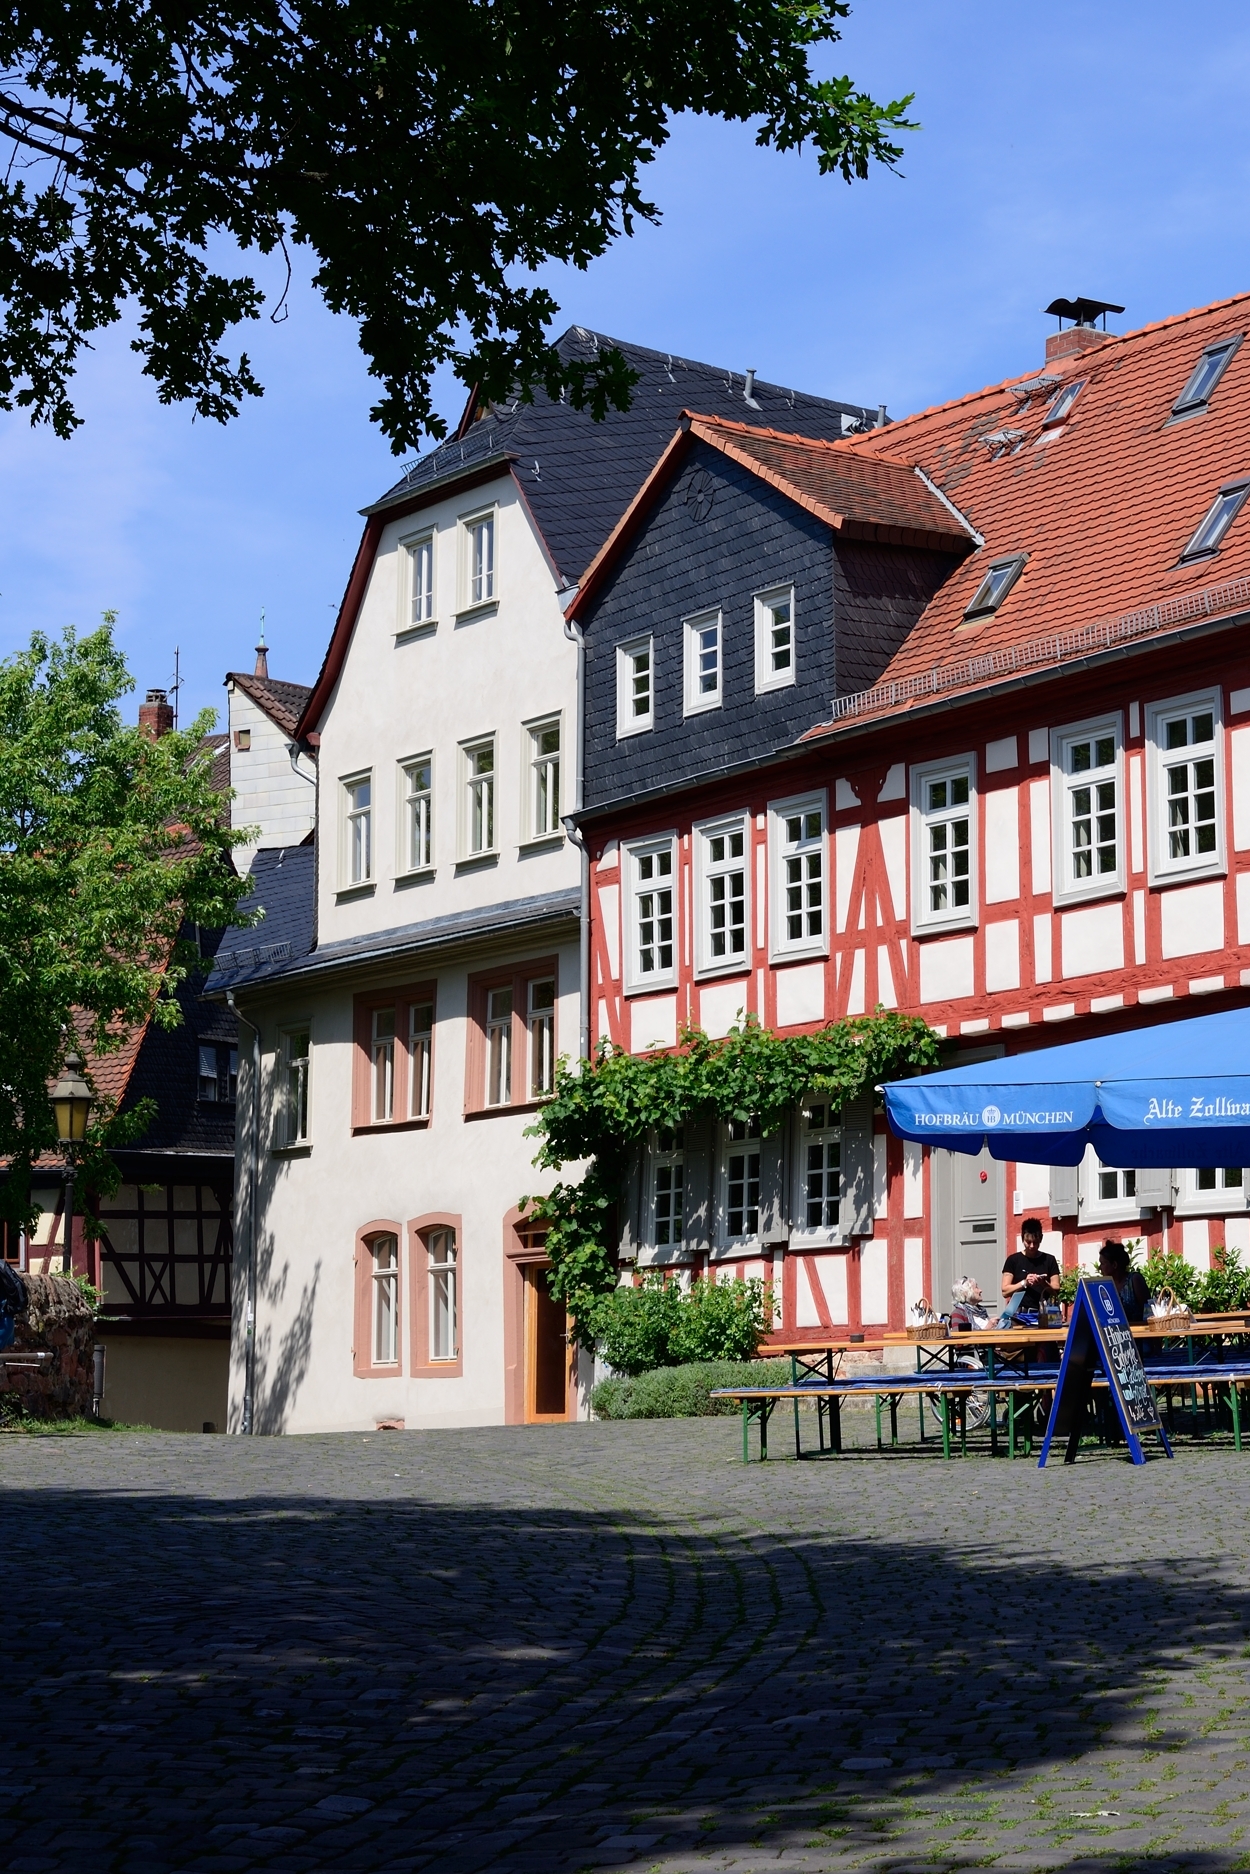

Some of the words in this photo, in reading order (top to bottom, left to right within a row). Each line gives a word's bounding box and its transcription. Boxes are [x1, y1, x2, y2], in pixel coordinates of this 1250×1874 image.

[915, 1111, 980, 1126] HOFBRÄU
[1003, 1111, 1073, 1125] MÜNCHEN
[1143, 1097, 1183, 1125] Alte
[1103, 1324, 1132, 1346] Himbeer
